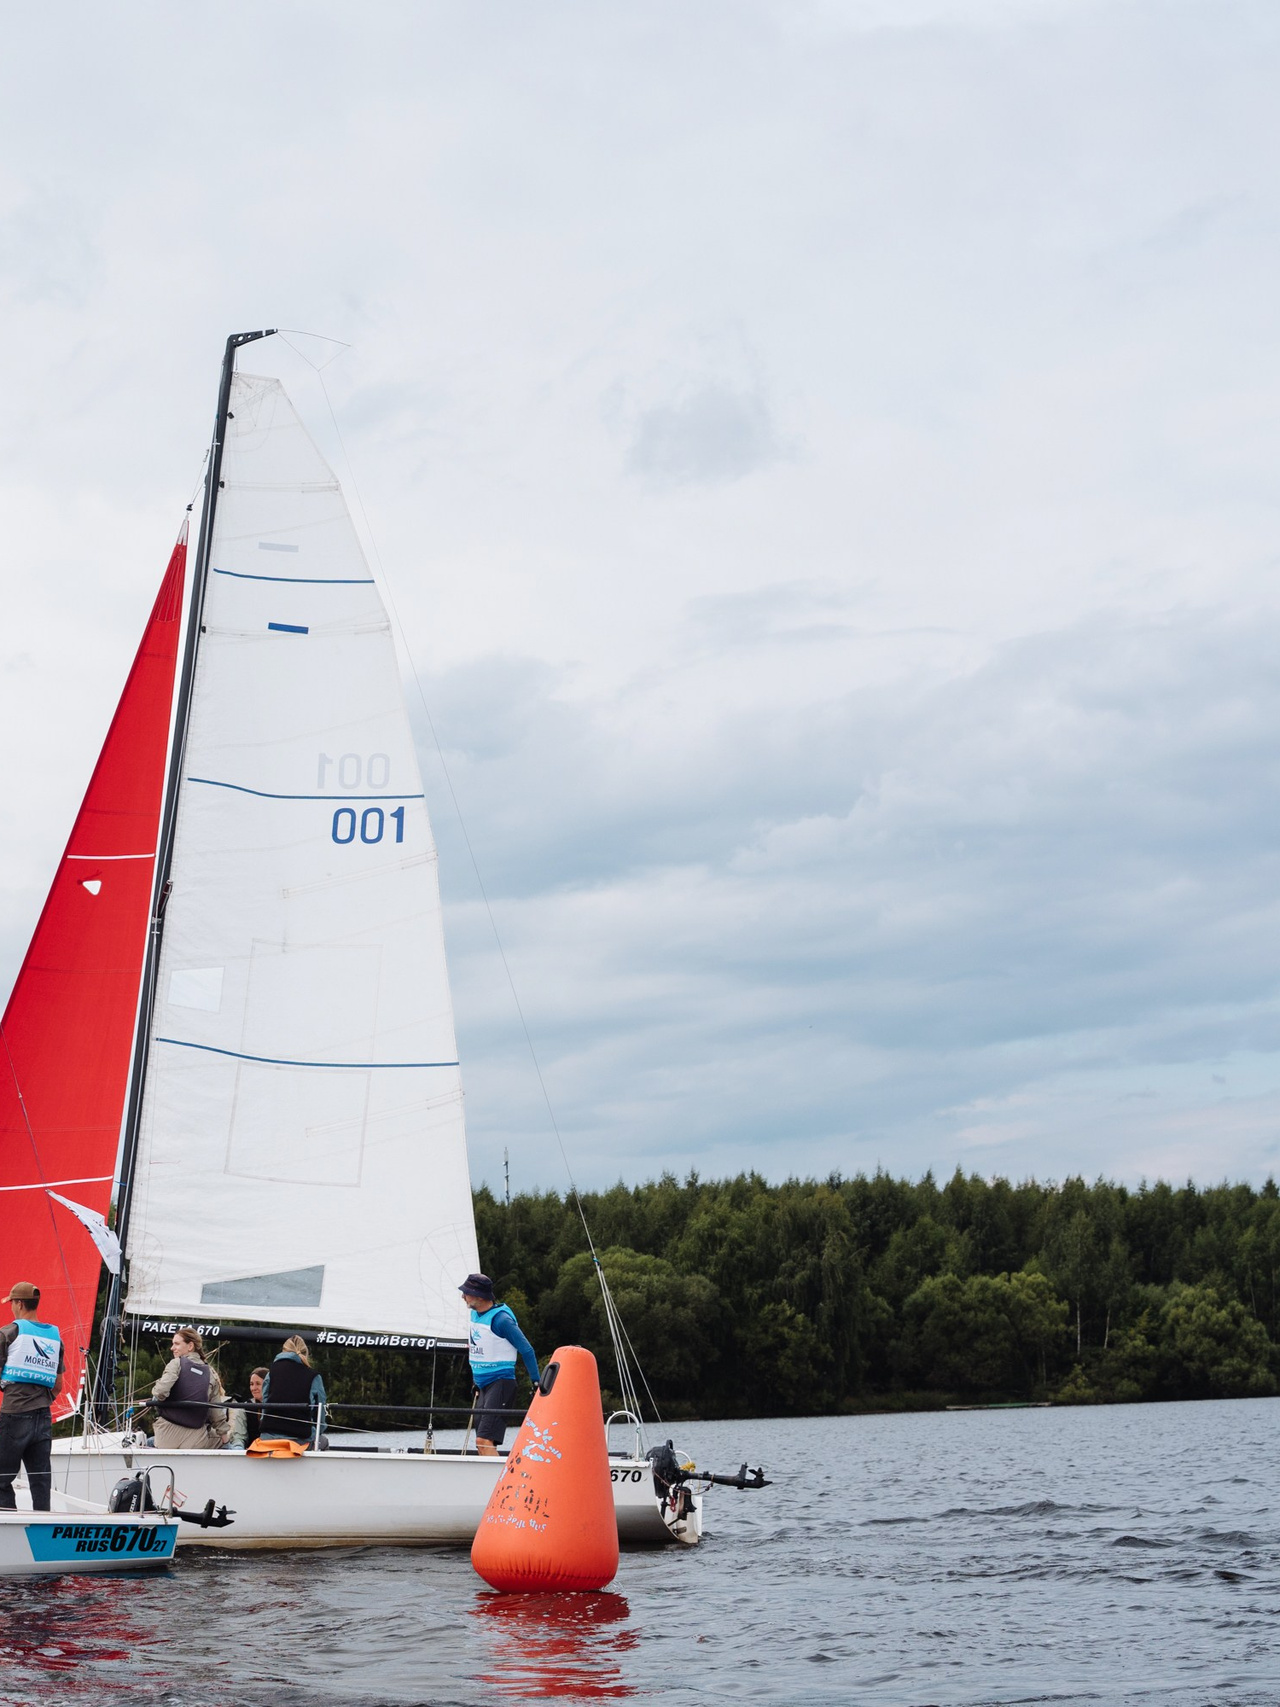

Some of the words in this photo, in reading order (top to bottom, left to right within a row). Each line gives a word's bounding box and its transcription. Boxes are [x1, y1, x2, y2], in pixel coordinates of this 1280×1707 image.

[332, 806, 404, 844] 001
[197, 1325, 220, 1336] 670
[316, 1331, 435, 1350] #БодрыйВетер
[24, 1355, 56, 1369] MORESAIL
[610, 1469, 642, 1483] 670
[75, 1540, 109, 1552] RUS
[109, 1526, 158, 1552] 670
[152, 1540, 168, 1552] 27
